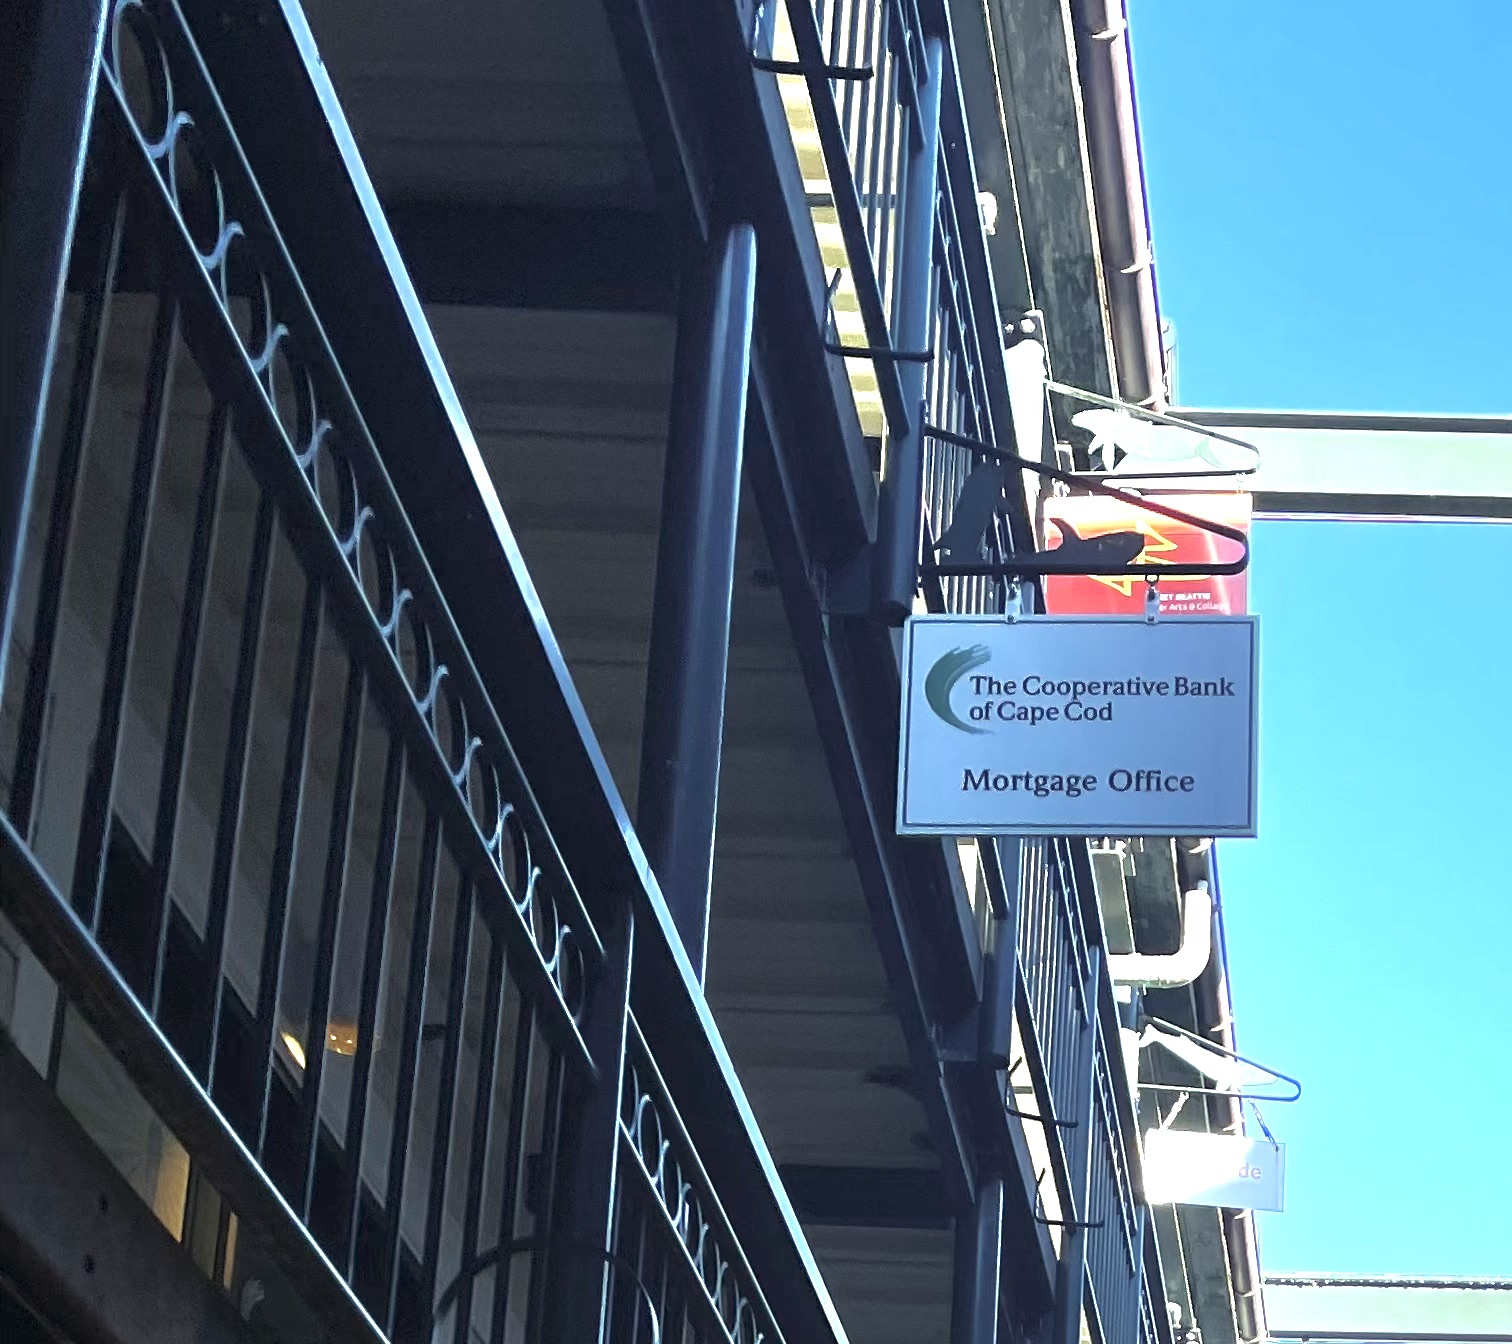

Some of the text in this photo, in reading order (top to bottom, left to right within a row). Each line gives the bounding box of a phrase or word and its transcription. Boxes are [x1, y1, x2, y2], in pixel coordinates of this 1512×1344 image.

[969, 675, 1236, 703] The Cooperative Bank
[969, 701, 1113, 726] of Cape Cod
[961, 769, 1195, 798] Mortgage Office
